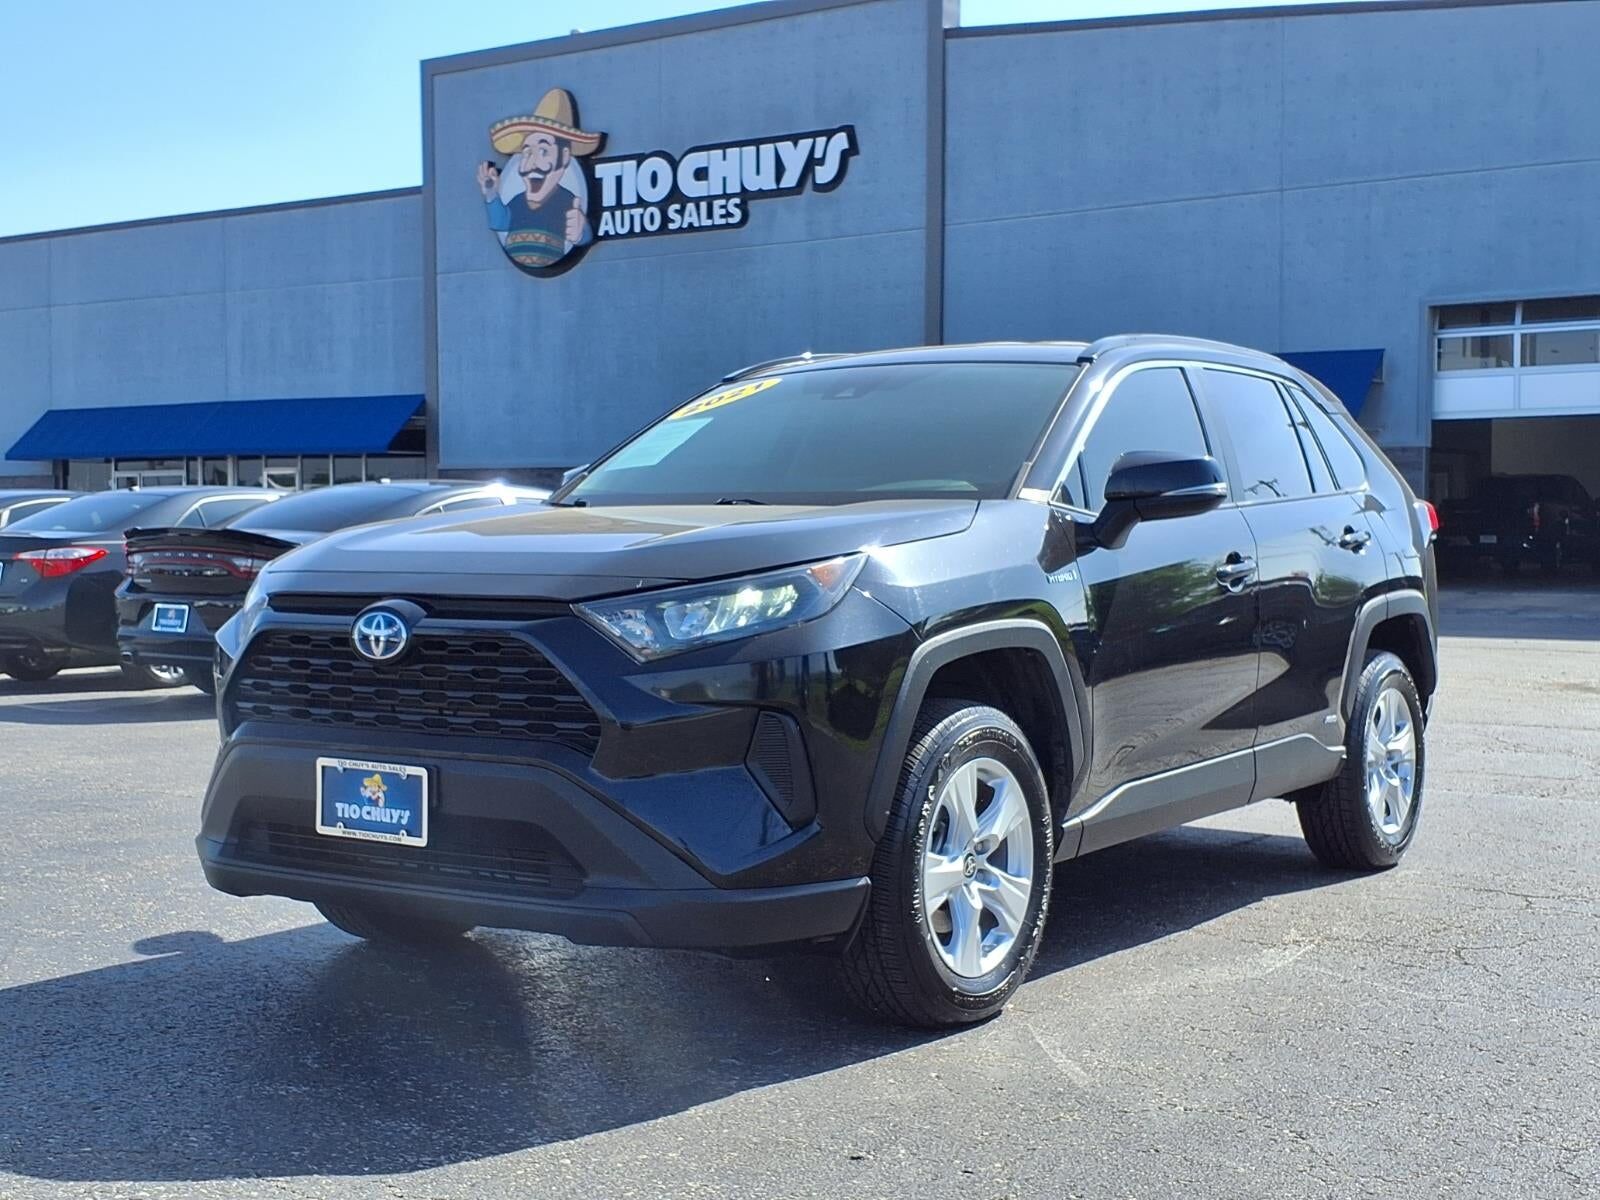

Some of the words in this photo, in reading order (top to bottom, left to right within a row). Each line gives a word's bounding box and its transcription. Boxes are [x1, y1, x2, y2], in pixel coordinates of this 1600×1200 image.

[595, 157, 673, 207] TIO
[677, 132, 849, 199] CHUY'S
[597, 206, 661, 236] AUTO
[667, 198, 742, 230] SALES
[335, 802, 360, 819] TIO
[361, 805, 410, 825] CHUY'S
